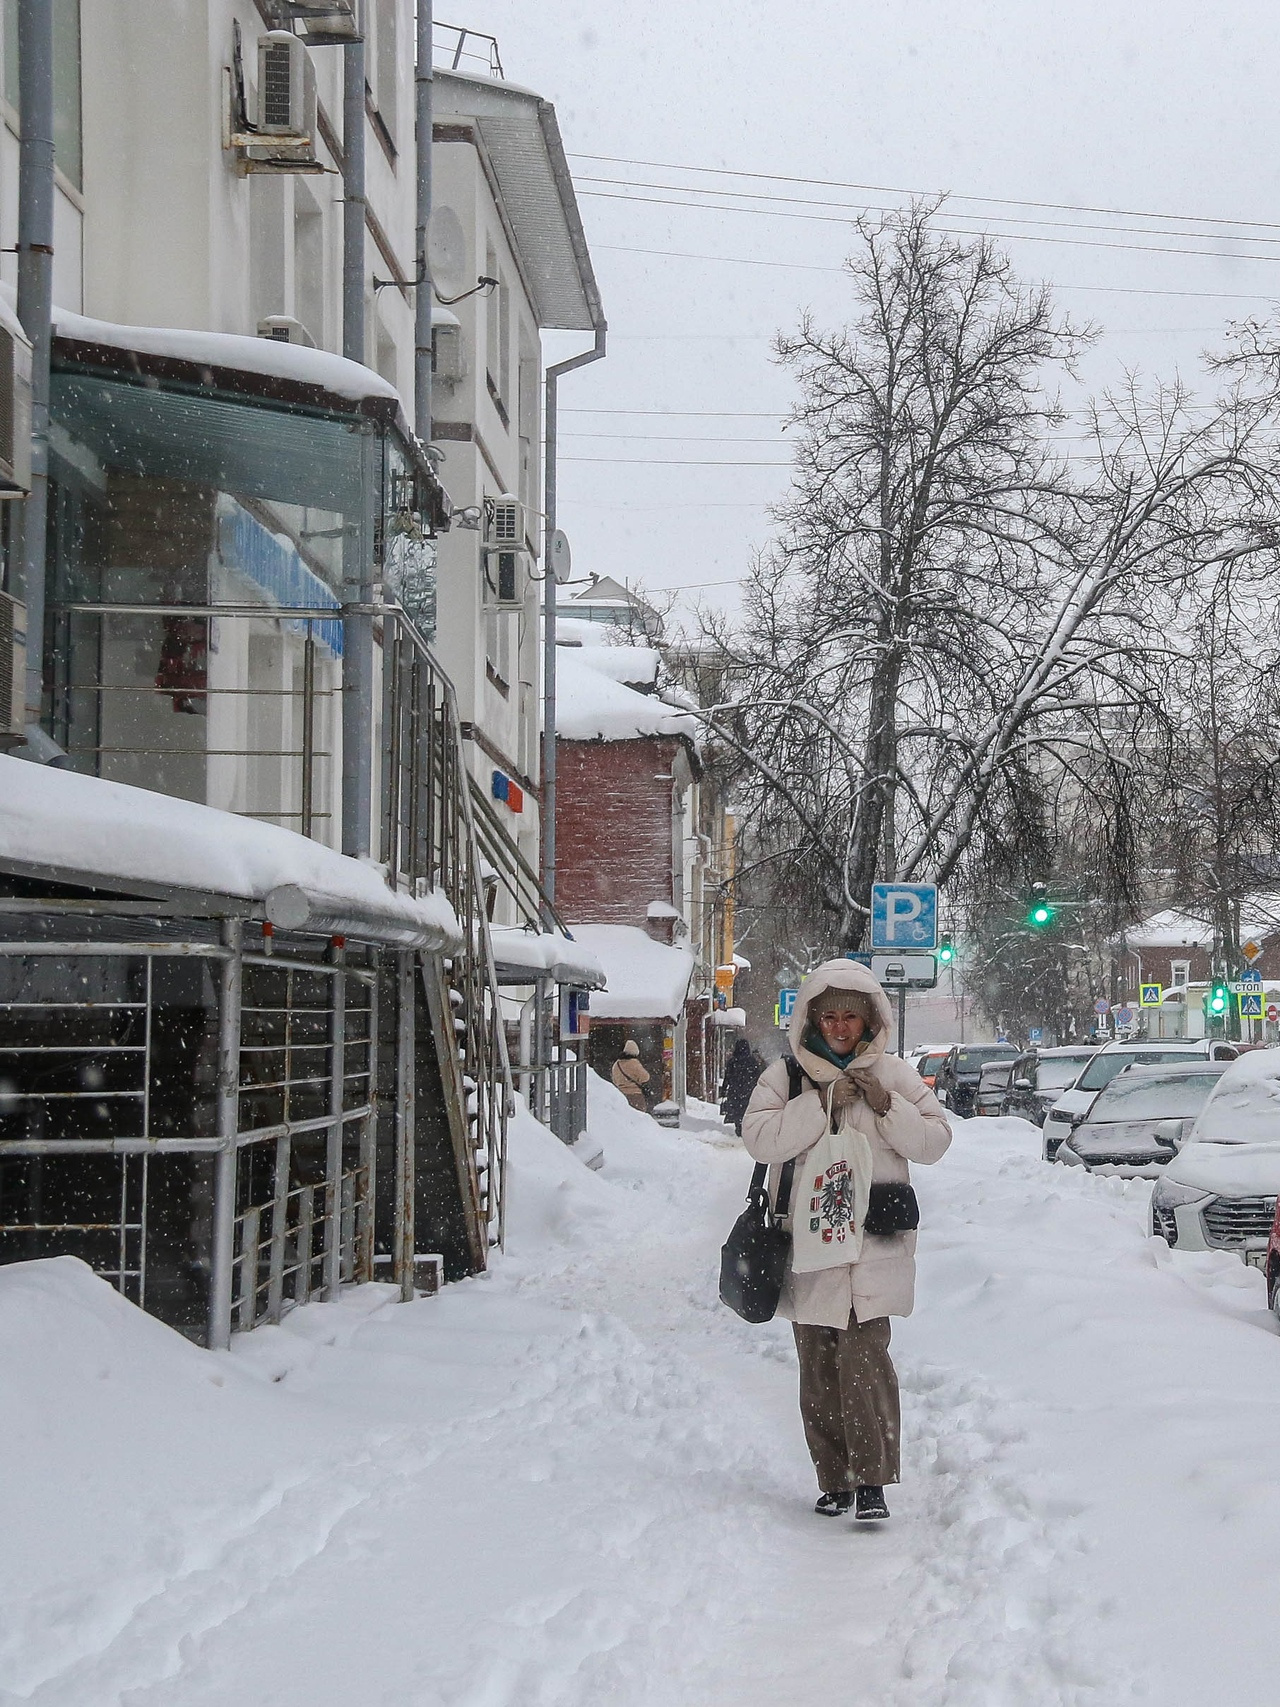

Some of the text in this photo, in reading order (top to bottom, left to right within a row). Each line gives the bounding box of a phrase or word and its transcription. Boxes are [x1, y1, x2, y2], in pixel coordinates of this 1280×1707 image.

[885, 891, 922, 941] P
[1235, 983, 1260, 992] СТОП
[1031, 1029, 1040, 1039] P
